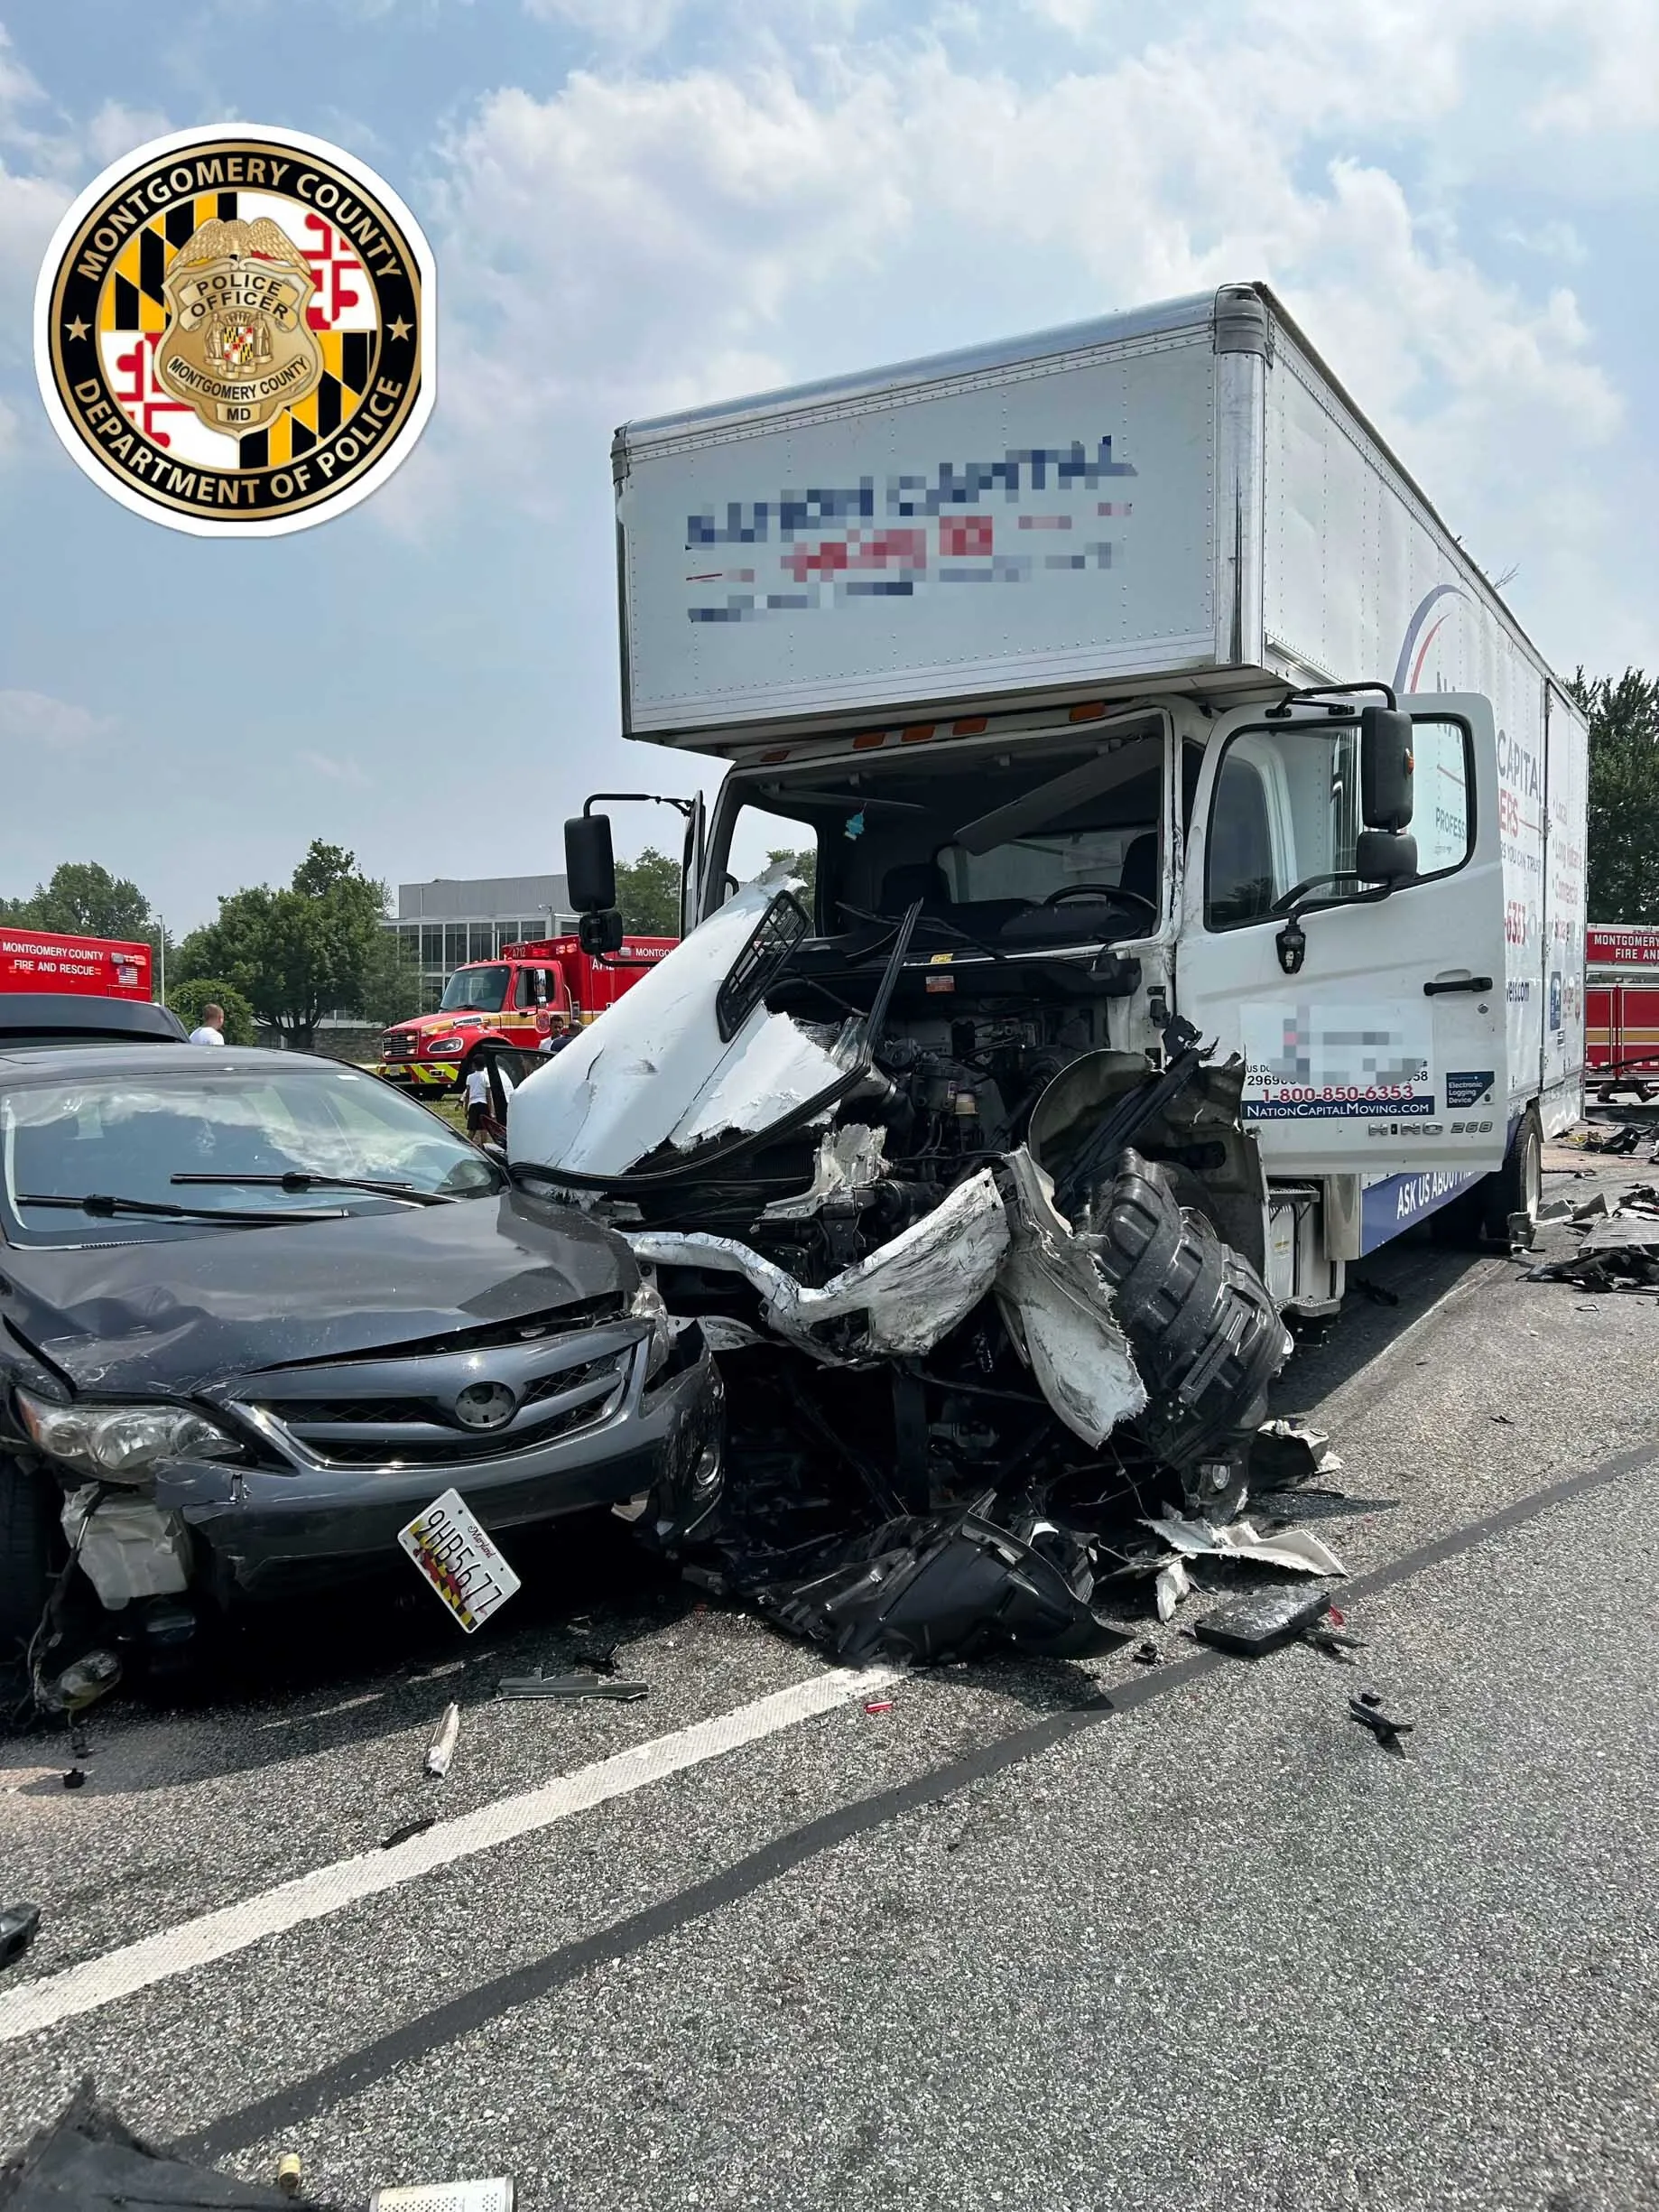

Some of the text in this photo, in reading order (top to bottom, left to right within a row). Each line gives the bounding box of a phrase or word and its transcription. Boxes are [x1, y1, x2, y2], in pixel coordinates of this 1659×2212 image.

[1594, 934, 1659, 947] MONTGOMERY
[3, 942, 104, 961] MONTGOMERY COUNTY
[635, 948, 673, 957] MONTGO
[1615, 948, 1659, 960] FIRE AN
[14, 960, 95, 976] FIRE AND RESCUE
[1247, 1064, 1258, 1073] US
[1247, 1075, 1298, 1086] 2969
[1263, 1083, 1413, 1103] 1-800-850-6353
[1448, 1089, 1477, 1097] Logging
[1367, 1120, 1494, 1137] HINO 268
[1396, 1179, 1417, 1220] ASK
[1418, 1173, 1430, 1207] US
[468, 1524, 497, 1559] Maryland
[418, 1509, 503, 1613] 9HB5677
